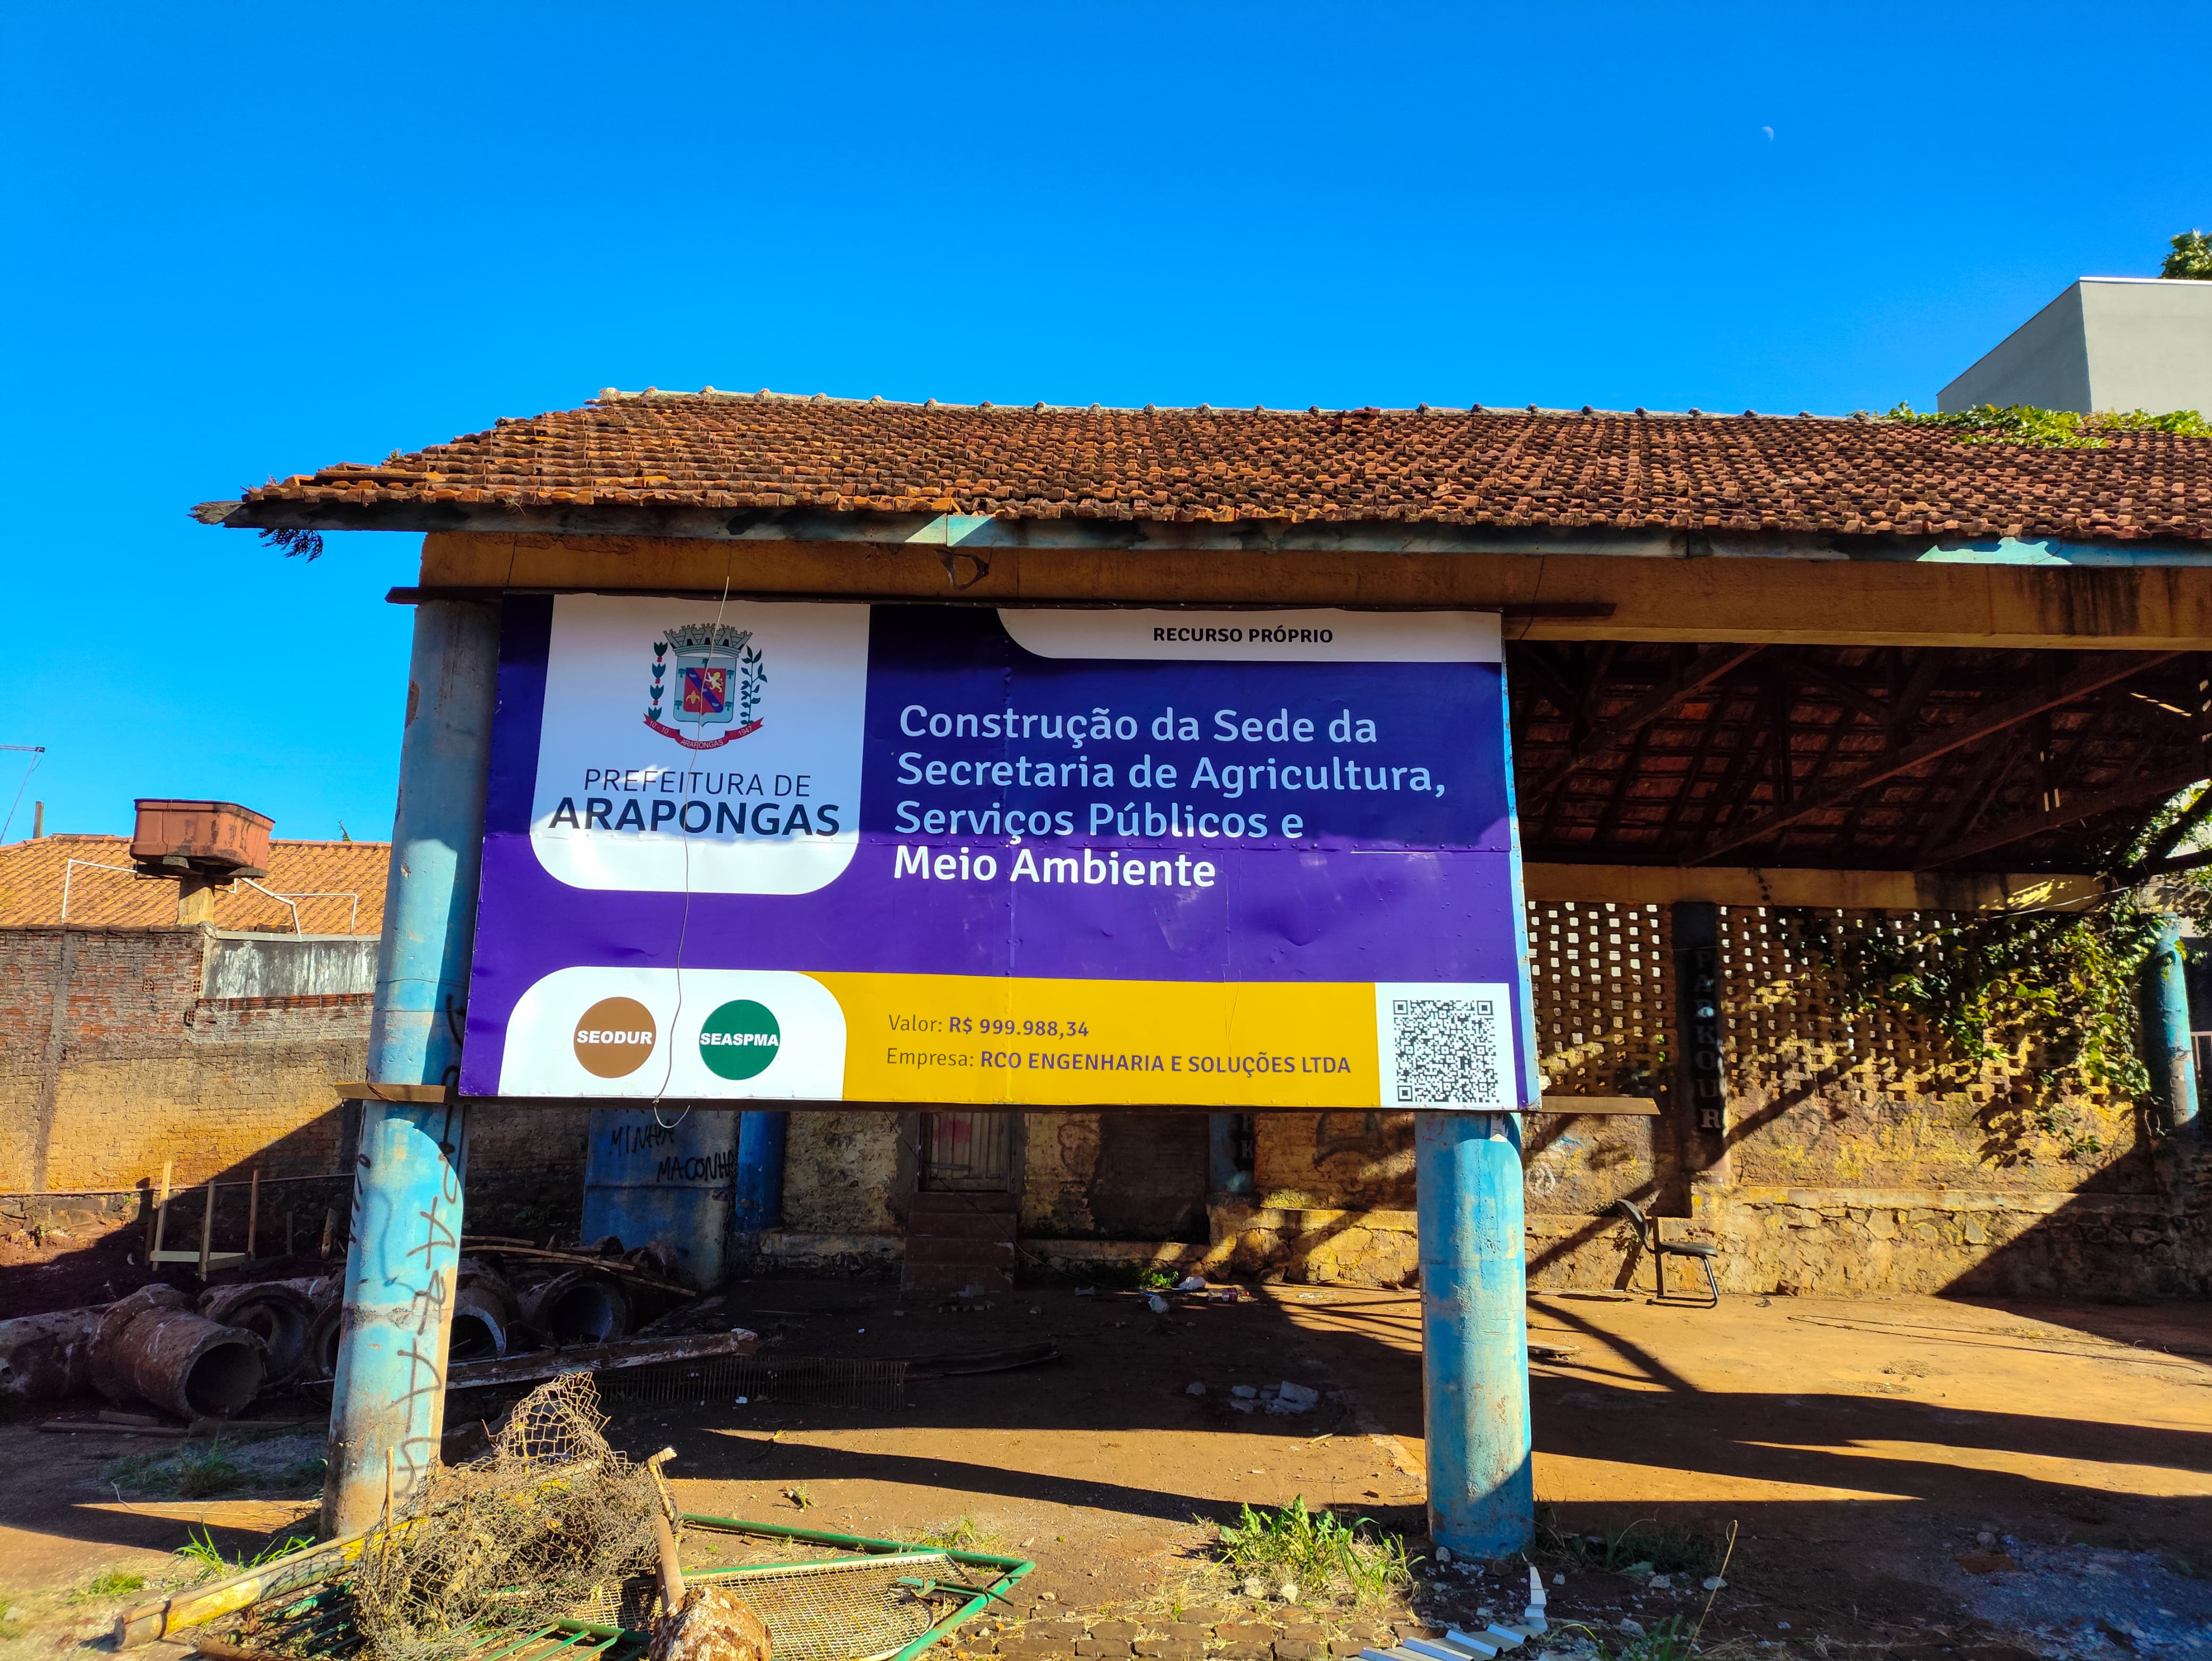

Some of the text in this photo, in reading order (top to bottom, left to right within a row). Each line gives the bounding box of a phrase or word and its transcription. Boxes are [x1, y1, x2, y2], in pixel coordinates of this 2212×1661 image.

[1153, 624, 1333, 643] RECURSO PRÓPRIO
[738, 725, 752, 737] 1947
[900, 704, 1377, 748] Construção da Sede da
[584, 769, 811, 797] PREFEITURA DE
[896, 752, 1446, 798] Secretaria de Agricultura,
[549, 797, 840, 837] ARAPONGAS
[894, 800, 1304, 845] Serviços Públicos e
[893, 845, 1216, 887] Meio Ambiente
[576, 1030, 653, 1045] SEODUR
[700, 1032, 779, 1047] SEASPMA
[888, 1014, 1089, 1039] Valor: R$ 999.988,34
[886, 1048, 1352, 1078] Empresa: RCO ENGENHARIA E SOLUÇÕES LTDA
[609, 1119, 675, 1157] MINHA
[657, 1151, 735, 1182] MACONHA
